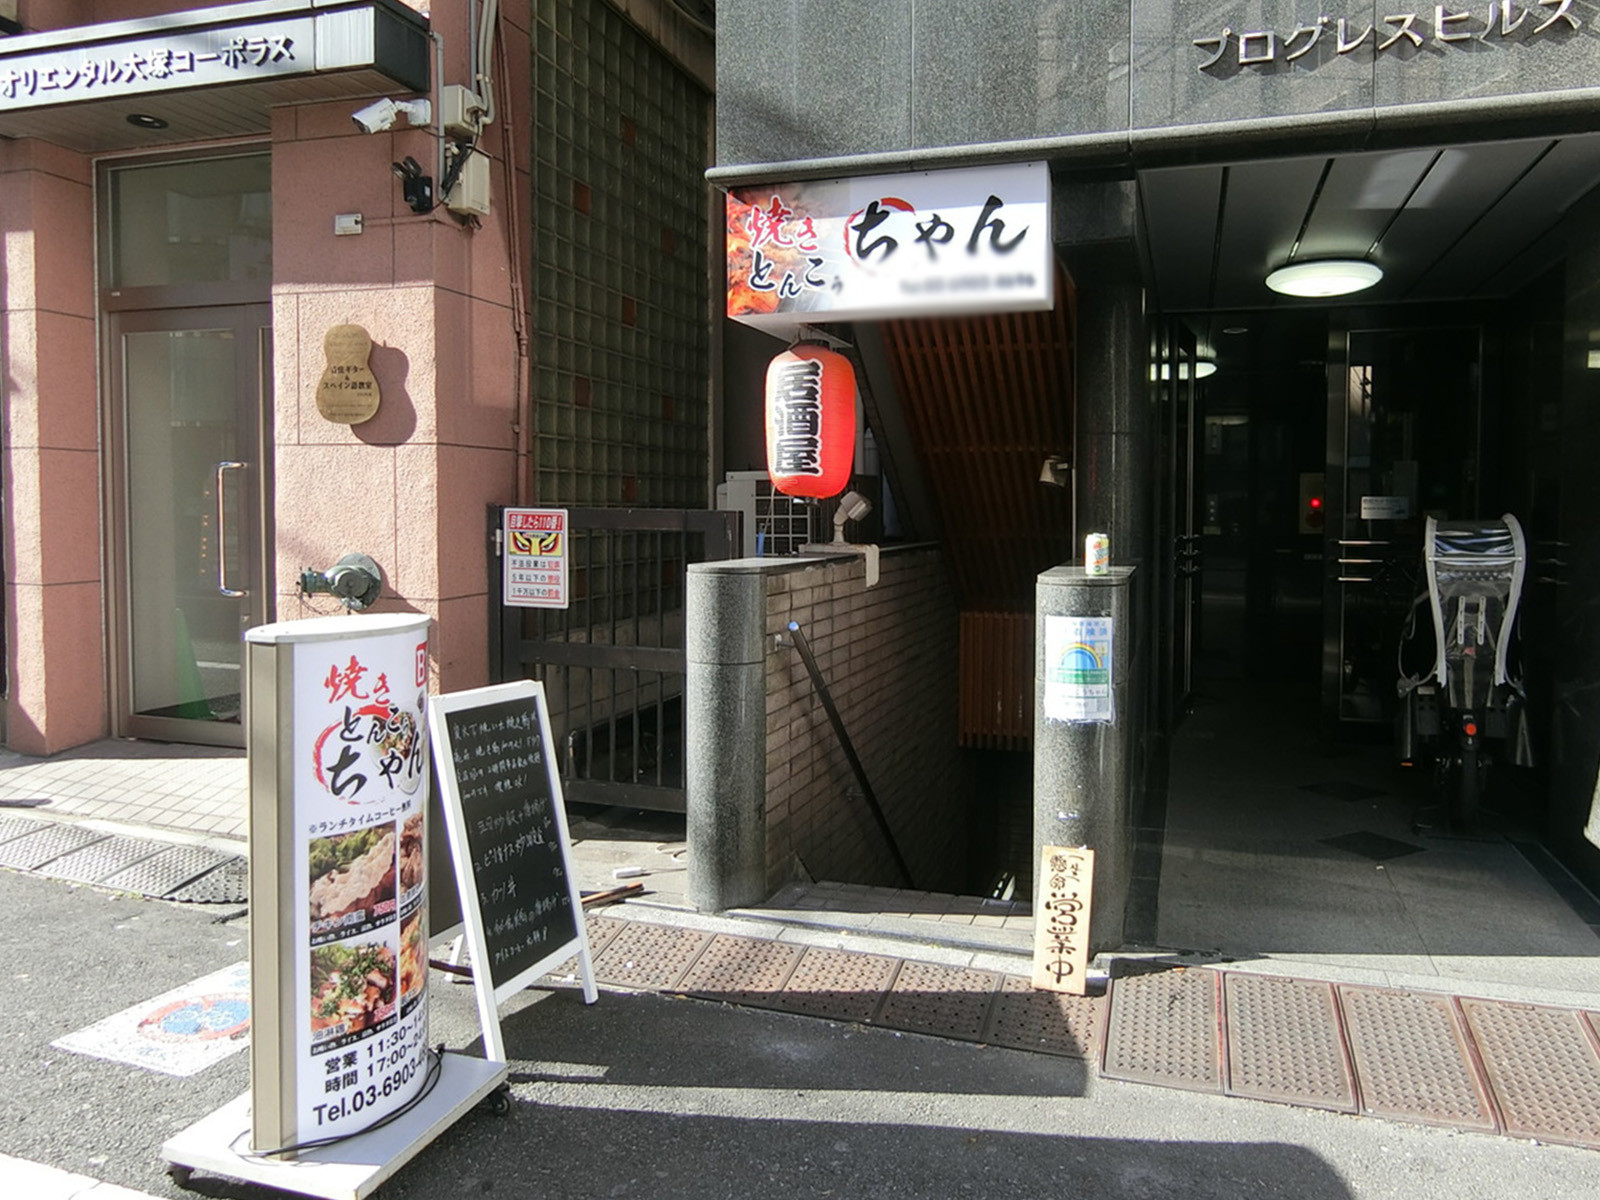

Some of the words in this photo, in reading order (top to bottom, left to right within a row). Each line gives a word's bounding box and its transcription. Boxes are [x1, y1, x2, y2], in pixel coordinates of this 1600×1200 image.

[1, 34, 297, 98] オリエンタル大塚コーポラス
[747, 195, 820, 251] 焼き
[849, 194, 1030, 264] ちゃん
[775, 360, 822, 476] 居酒屋
[324, 655, 391, 706] 焼き
[327, 731, 424, 799] ちゃん
[1045, 892, 1084, 985] 営業中
[324, 1050, 358, 1075] 営業
[324, 1070, 358, 1093] 時間
